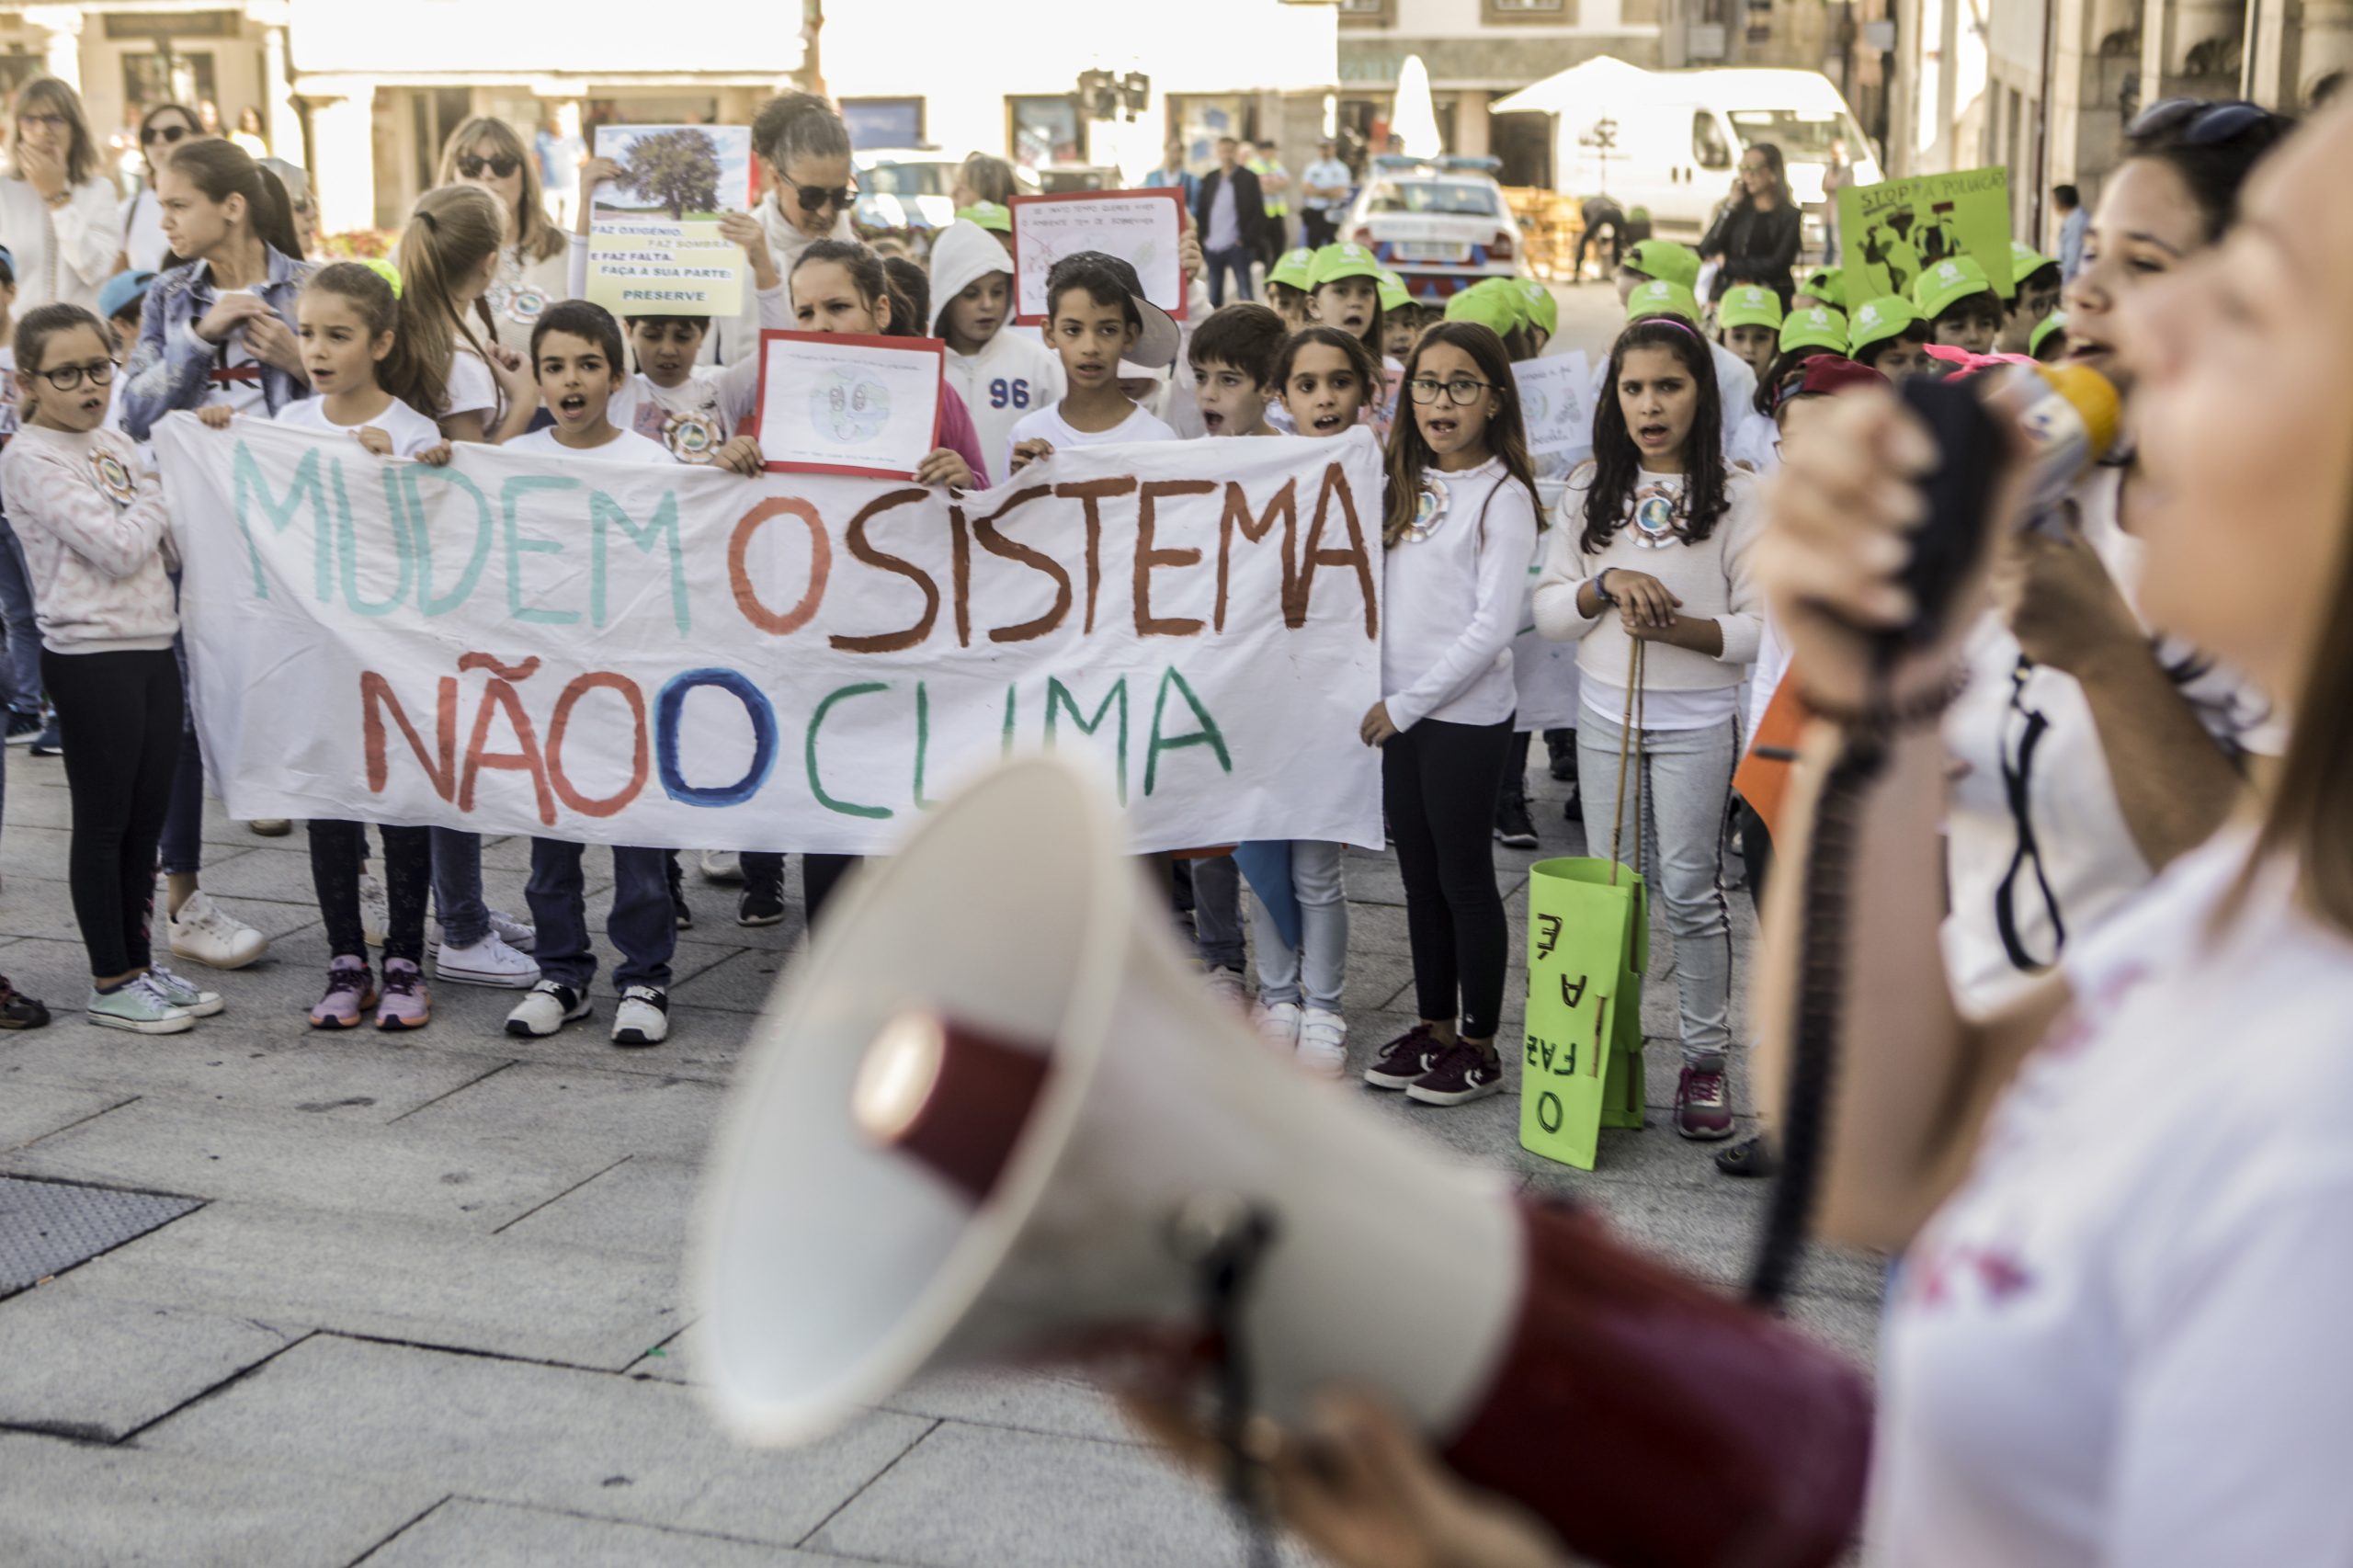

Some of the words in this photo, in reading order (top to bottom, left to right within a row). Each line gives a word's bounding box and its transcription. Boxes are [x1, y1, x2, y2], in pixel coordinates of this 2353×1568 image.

[1859, 186, 1910, 210] STOP
[591, 225, 615, 234] FAZ
[648, 239, 673, 248] FAZ
[591, 253, 598, 261] E
[602, 253, 626, 261] FAZ
[601, 266, 636, 276] FAÇA
[639, 267, 649, 275] A
[653, 267, 680, 277] SUA
[623, 290, 706, 301] PRESERVE
[989, 378, 1030, 410] 96
[233, 439, 691, 640] MUDEM
[728, 494, 832, 636] O
[829, 460, 1378, 654] SISTEMA
[359, 651, 649, 827] NÃO
[653, 667, 779, 808] O
[805, 665, 1233, 820] CLIMA
[1526, 1033, 1576, 1076] FAZ
[1536, 1090, 1563, 1134] O
